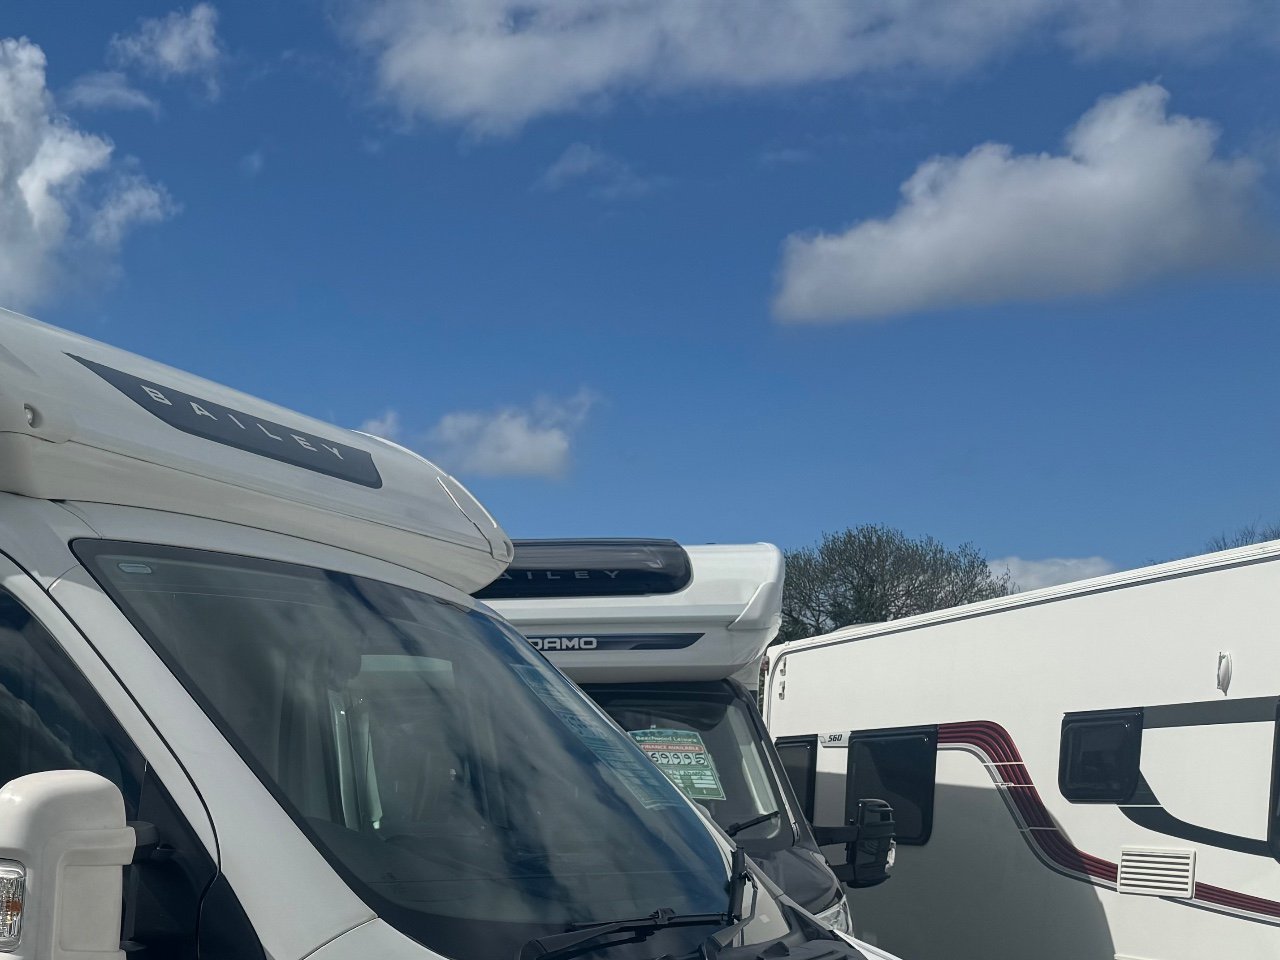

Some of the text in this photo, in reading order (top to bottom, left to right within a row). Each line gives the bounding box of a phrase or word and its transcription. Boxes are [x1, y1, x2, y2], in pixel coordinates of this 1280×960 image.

[141, 384, 344, 460] BAILEY
[500, 570, 620, 580] AILEY
[528, 637, 598, 650] DAMO
